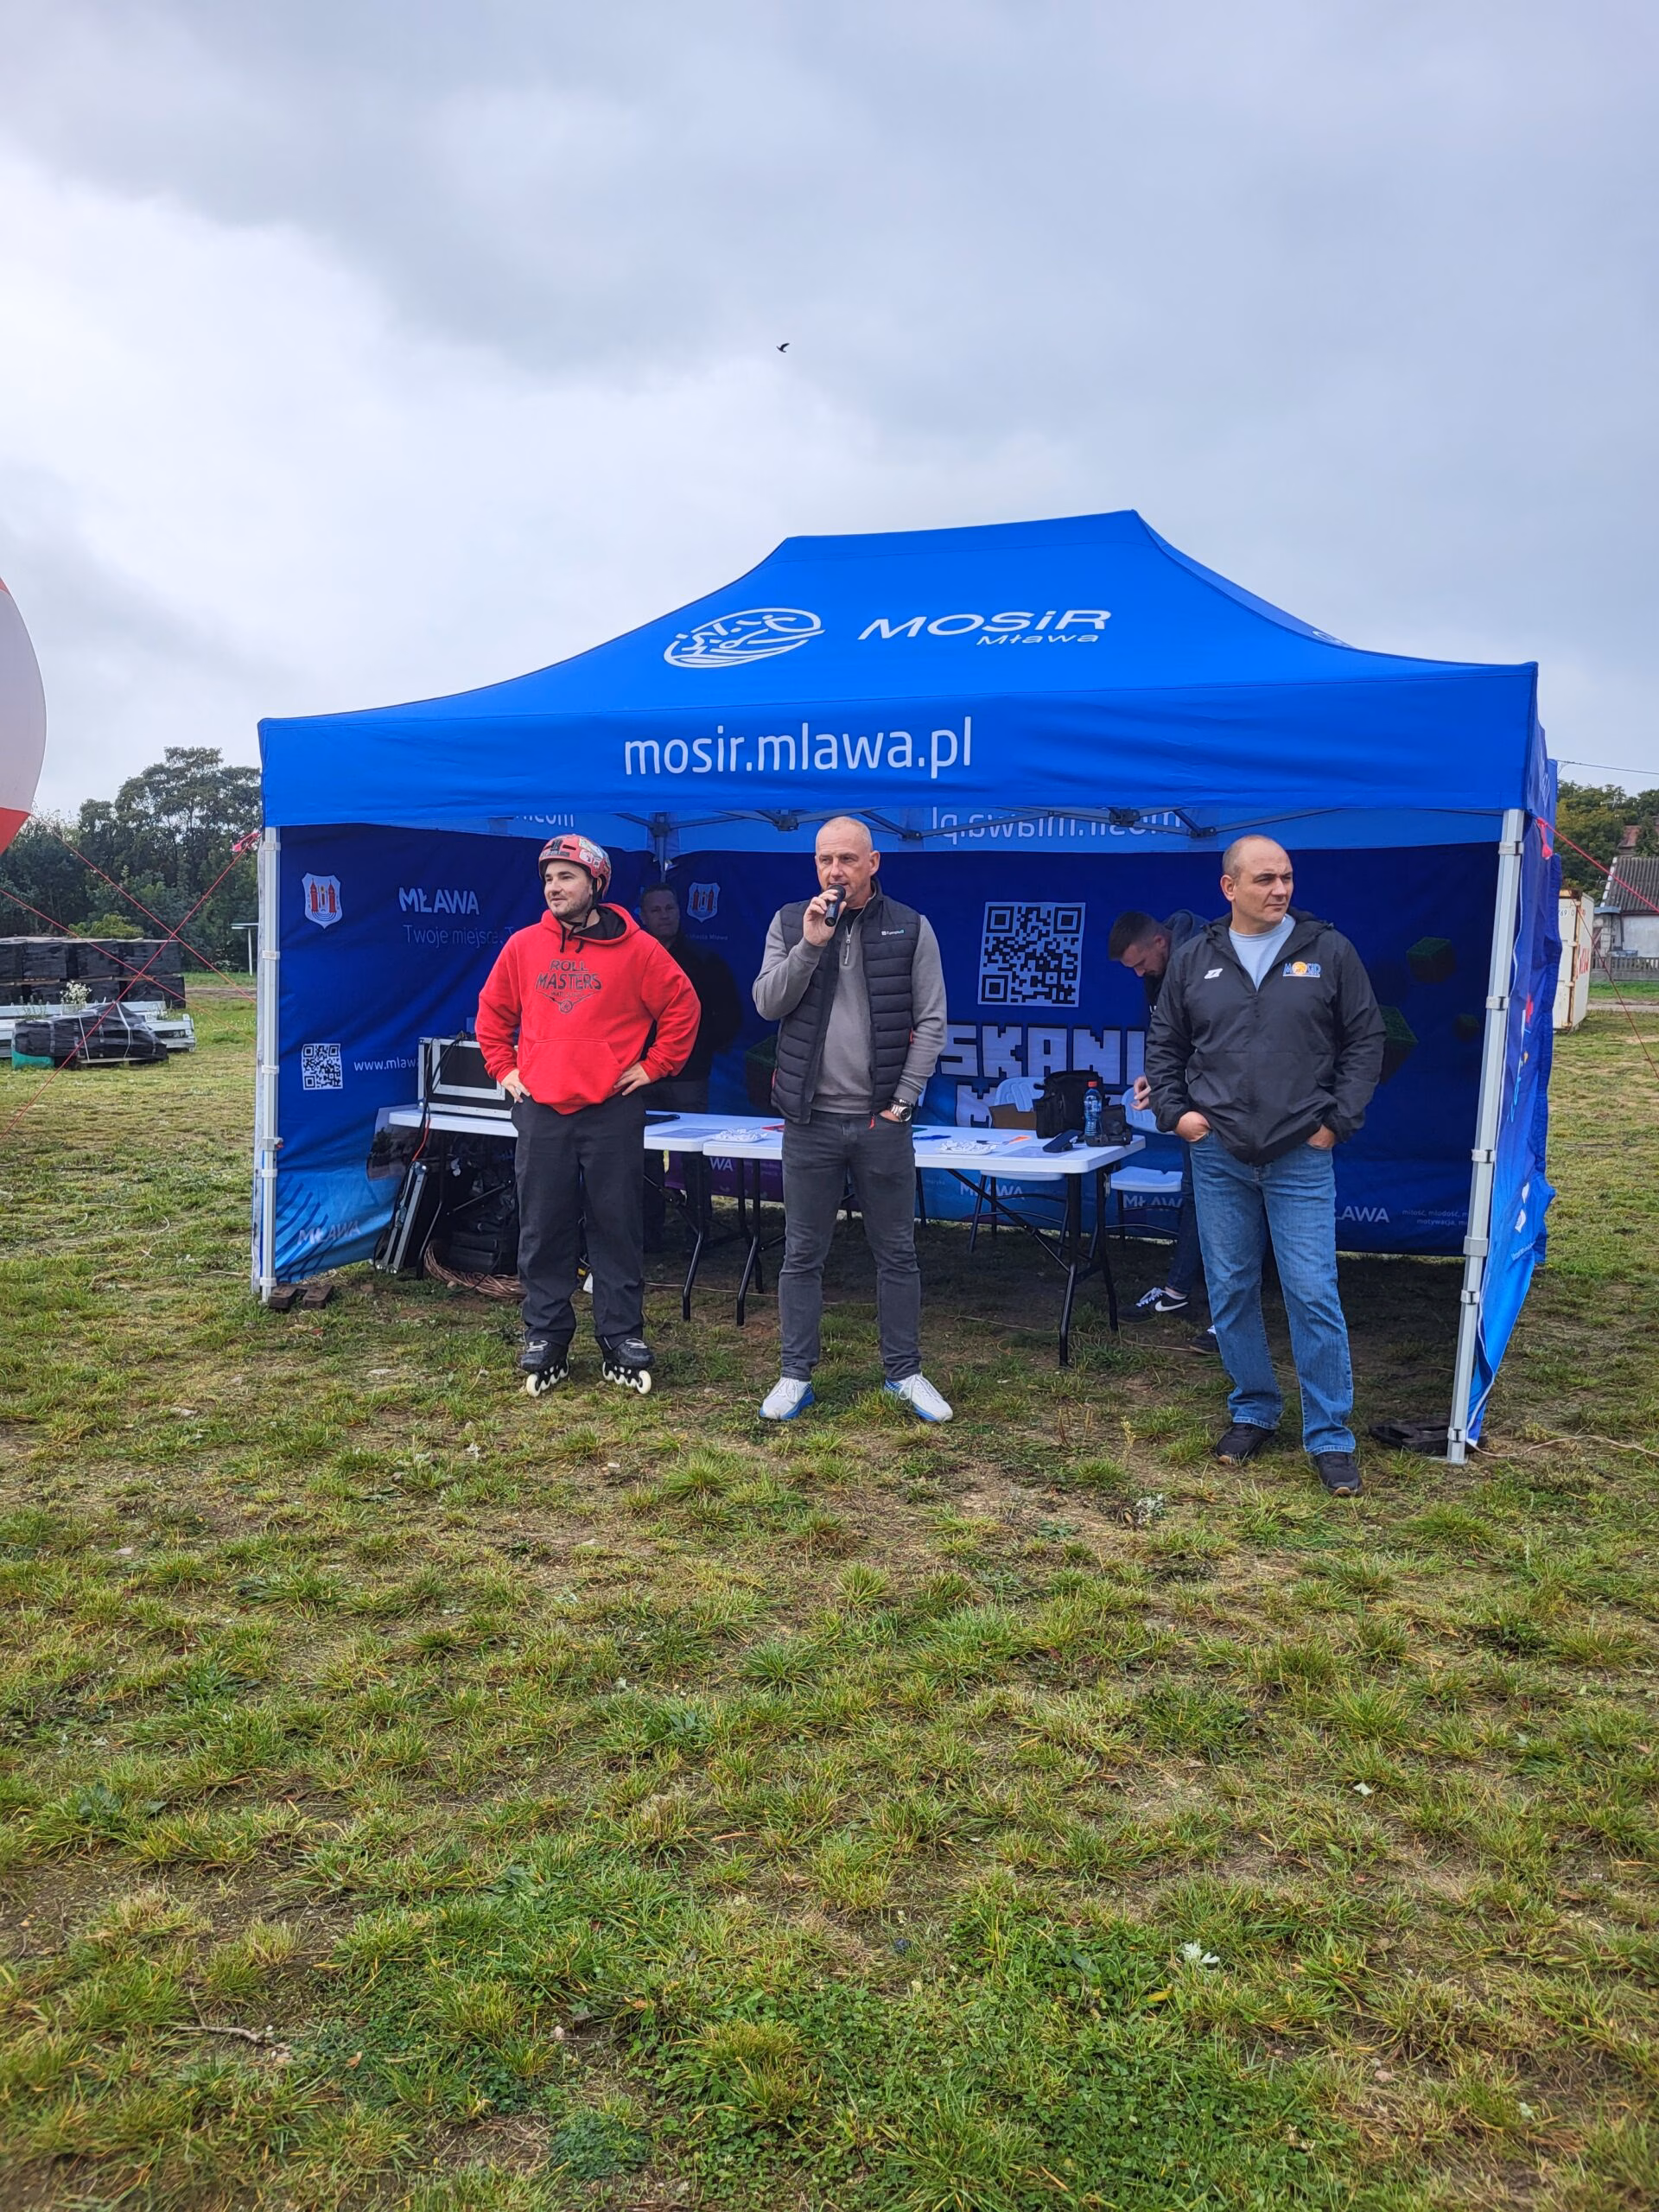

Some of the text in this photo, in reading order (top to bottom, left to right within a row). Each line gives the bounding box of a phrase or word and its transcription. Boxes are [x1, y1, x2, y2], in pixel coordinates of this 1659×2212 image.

[858, 610, 1111, 640] MOSiR
[976, 633, 1099, 645] Mława
[625, 716, 971, 779] mosir.mlawa.pl
[398, 887, 480, 915] MŁAWA
[403, 925, 448, 949] Twoje
[550, 959, 588, 972] ROLL
[535, 973, 602, 990] MASTERS
[1123, 1194, 1184, 1211] MŁAW
[297, 1220, 361, 1245] MŁAWA
